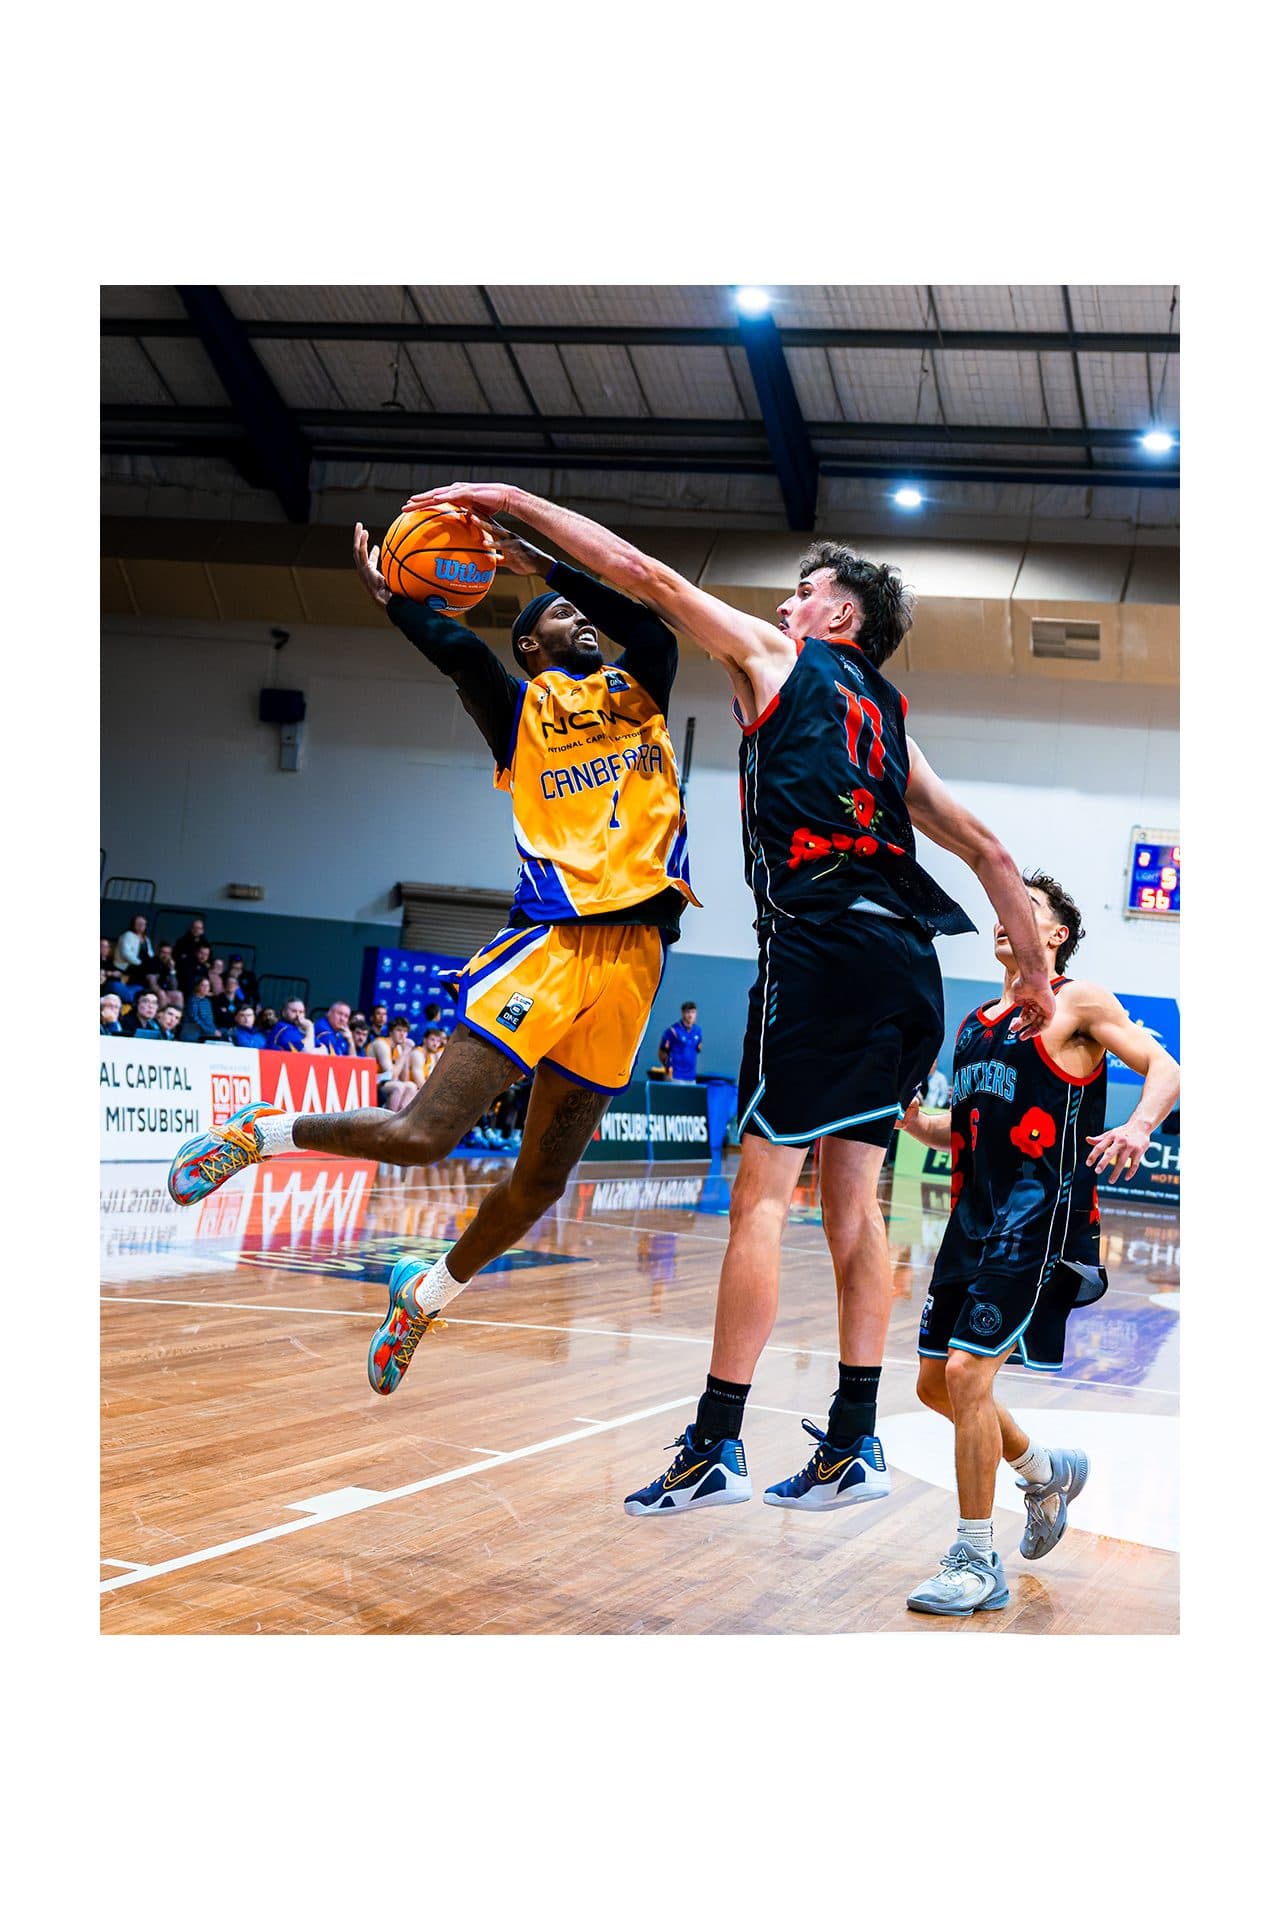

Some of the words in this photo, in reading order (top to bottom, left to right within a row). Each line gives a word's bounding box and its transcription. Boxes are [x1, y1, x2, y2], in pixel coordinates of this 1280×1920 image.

[541, 709, 642, 740] NCM
[608, 788, 621, 830] 1
[99, 1062, 121, 1088] AL
[126, 1063, 192, 1091] CAPITAL
[273, 1062, 370, 1114] AAMI
[106, 1106, 199, 1133] MITSUBISHI
[666, 1114, 709, 1143] MOTORS
